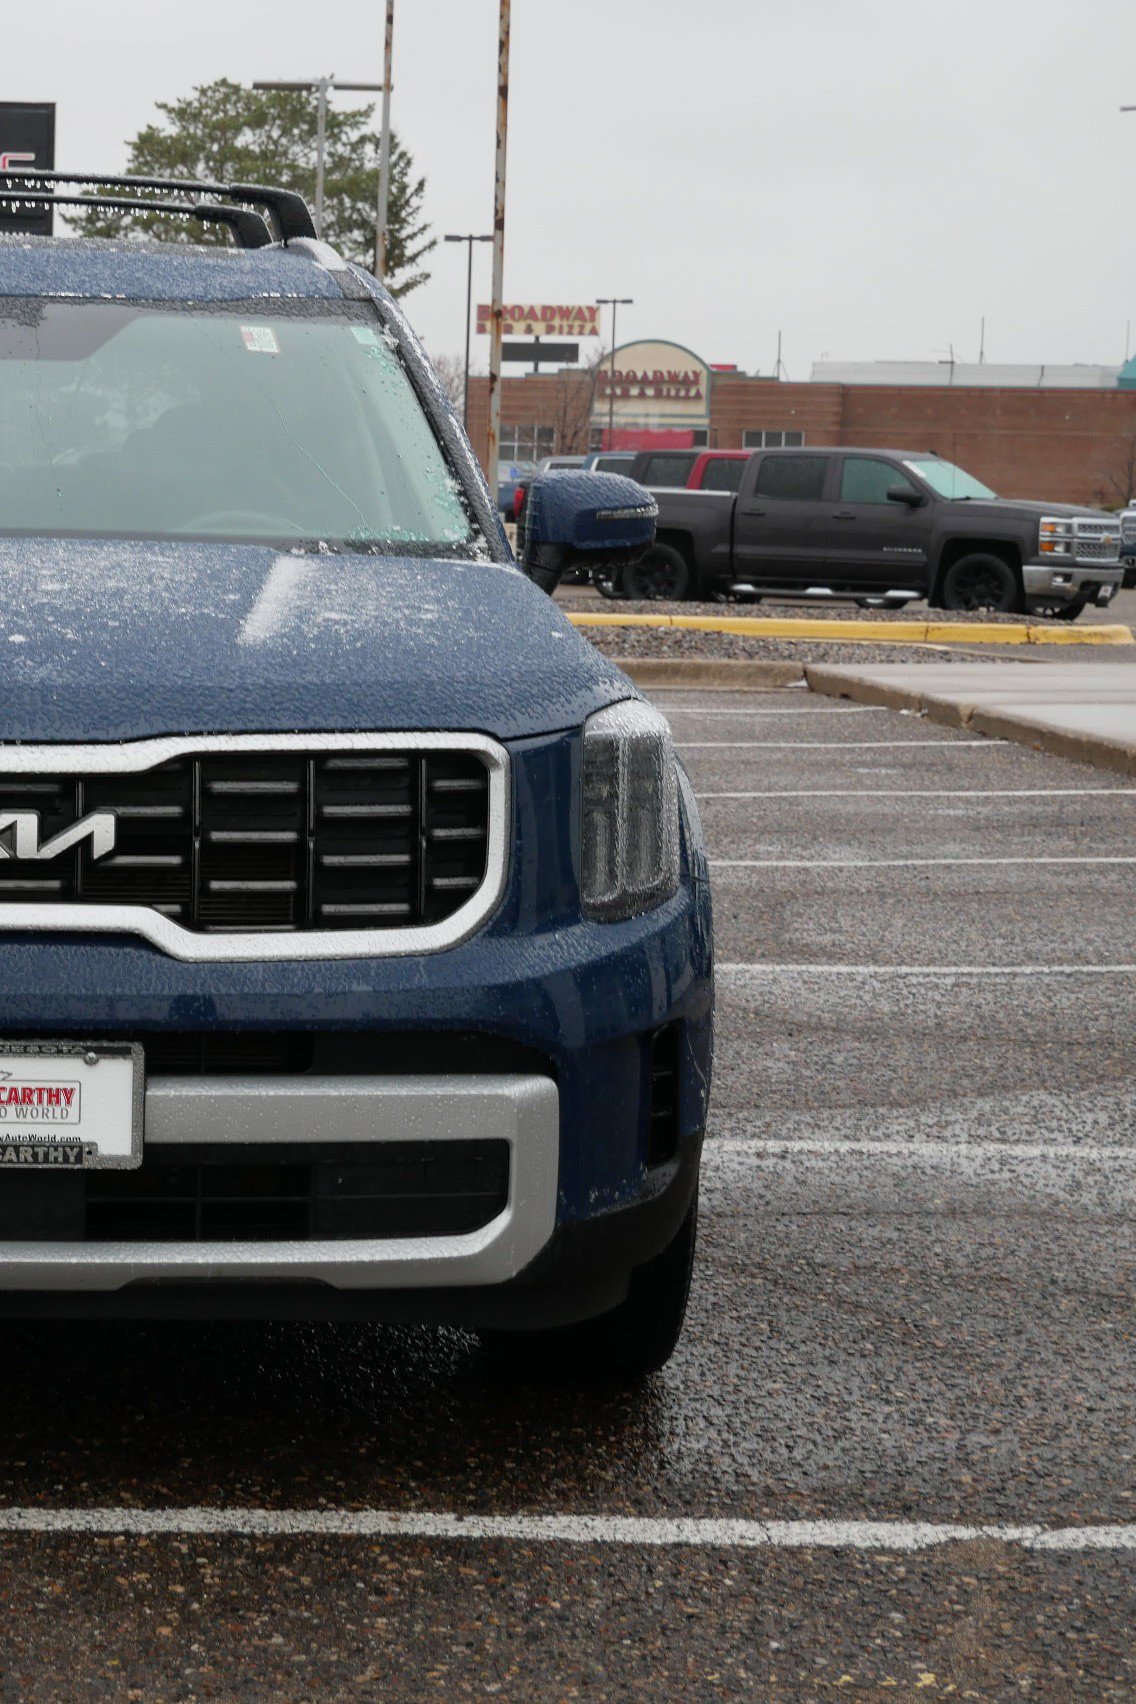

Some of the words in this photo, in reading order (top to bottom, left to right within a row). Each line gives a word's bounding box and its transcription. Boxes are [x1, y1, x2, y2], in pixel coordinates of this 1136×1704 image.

[476, 322, 514, 335] BR
[524, 323, 534, 335] &
[545, 323, 599, 336] PIZZA
[596, 369, 702, 386] BROADWAY
[14, 1107, 70, 1120] WORLD
